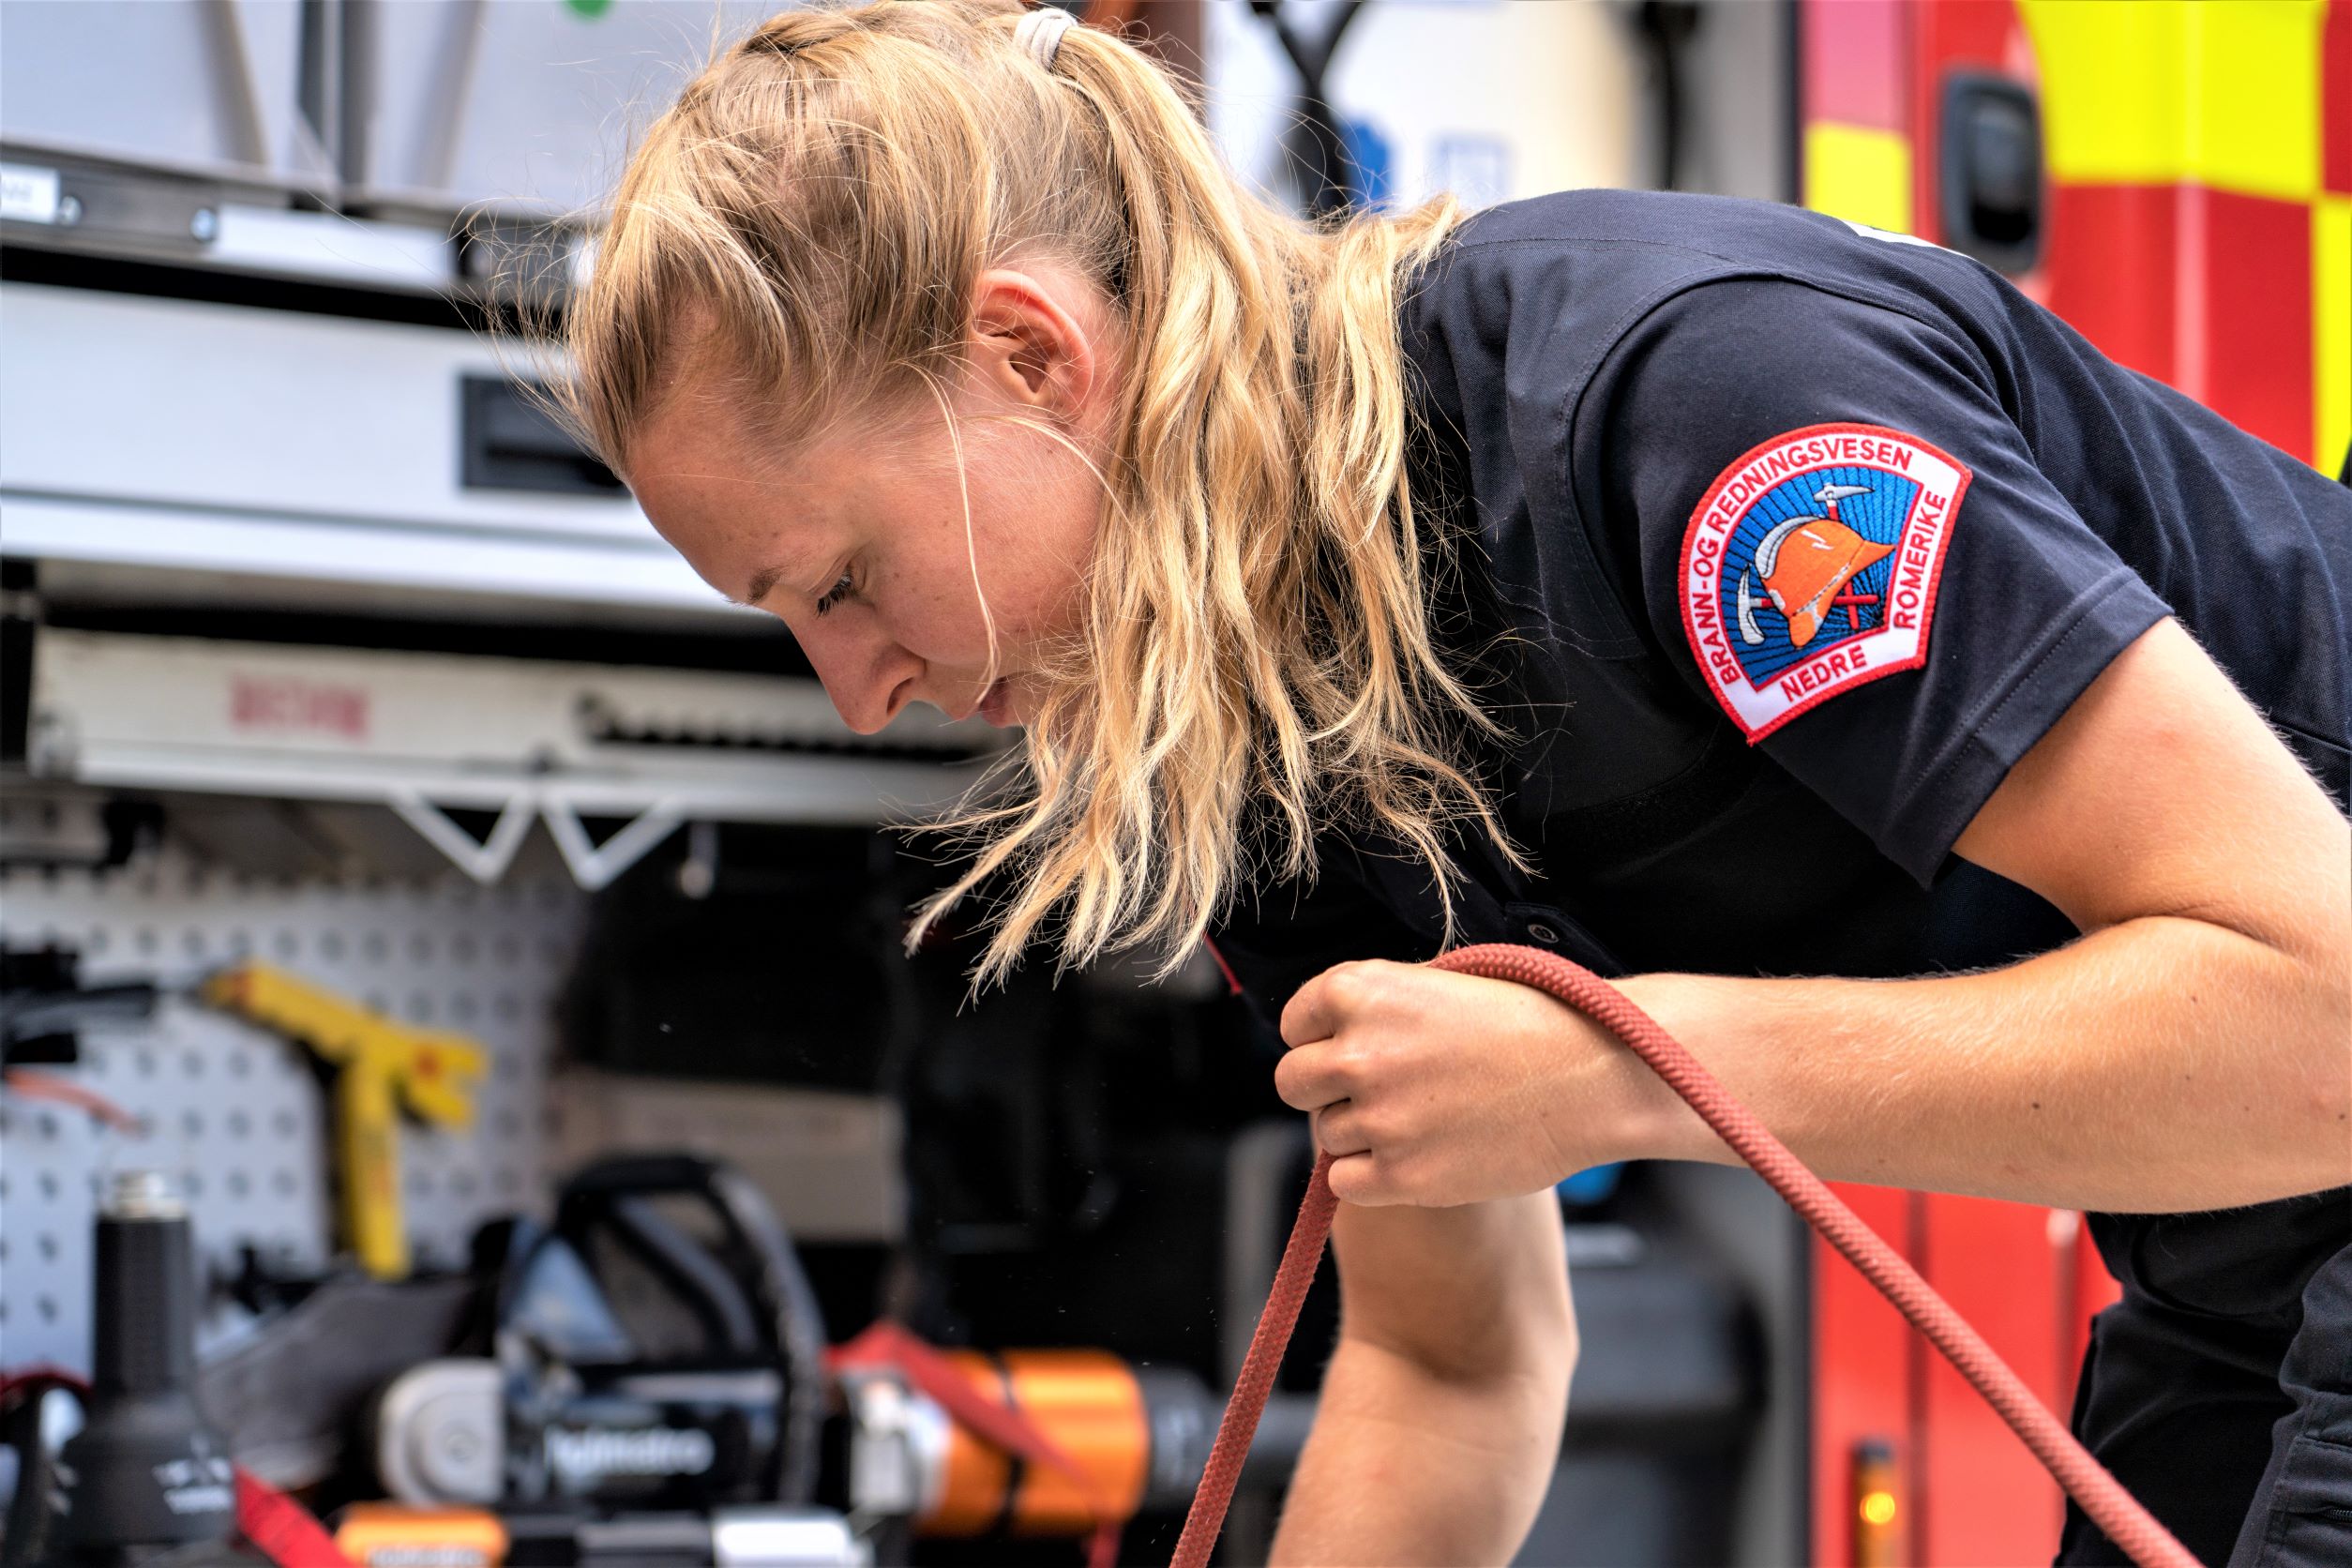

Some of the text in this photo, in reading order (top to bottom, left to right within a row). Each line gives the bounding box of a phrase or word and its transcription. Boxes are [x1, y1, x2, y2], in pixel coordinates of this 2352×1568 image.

[1706, 438, 1913, 535] REDNINGSVESEN
[1893, 490, 1947, 630] ROMERIKE
[1779, 644, 1868, 702] NEDRE
